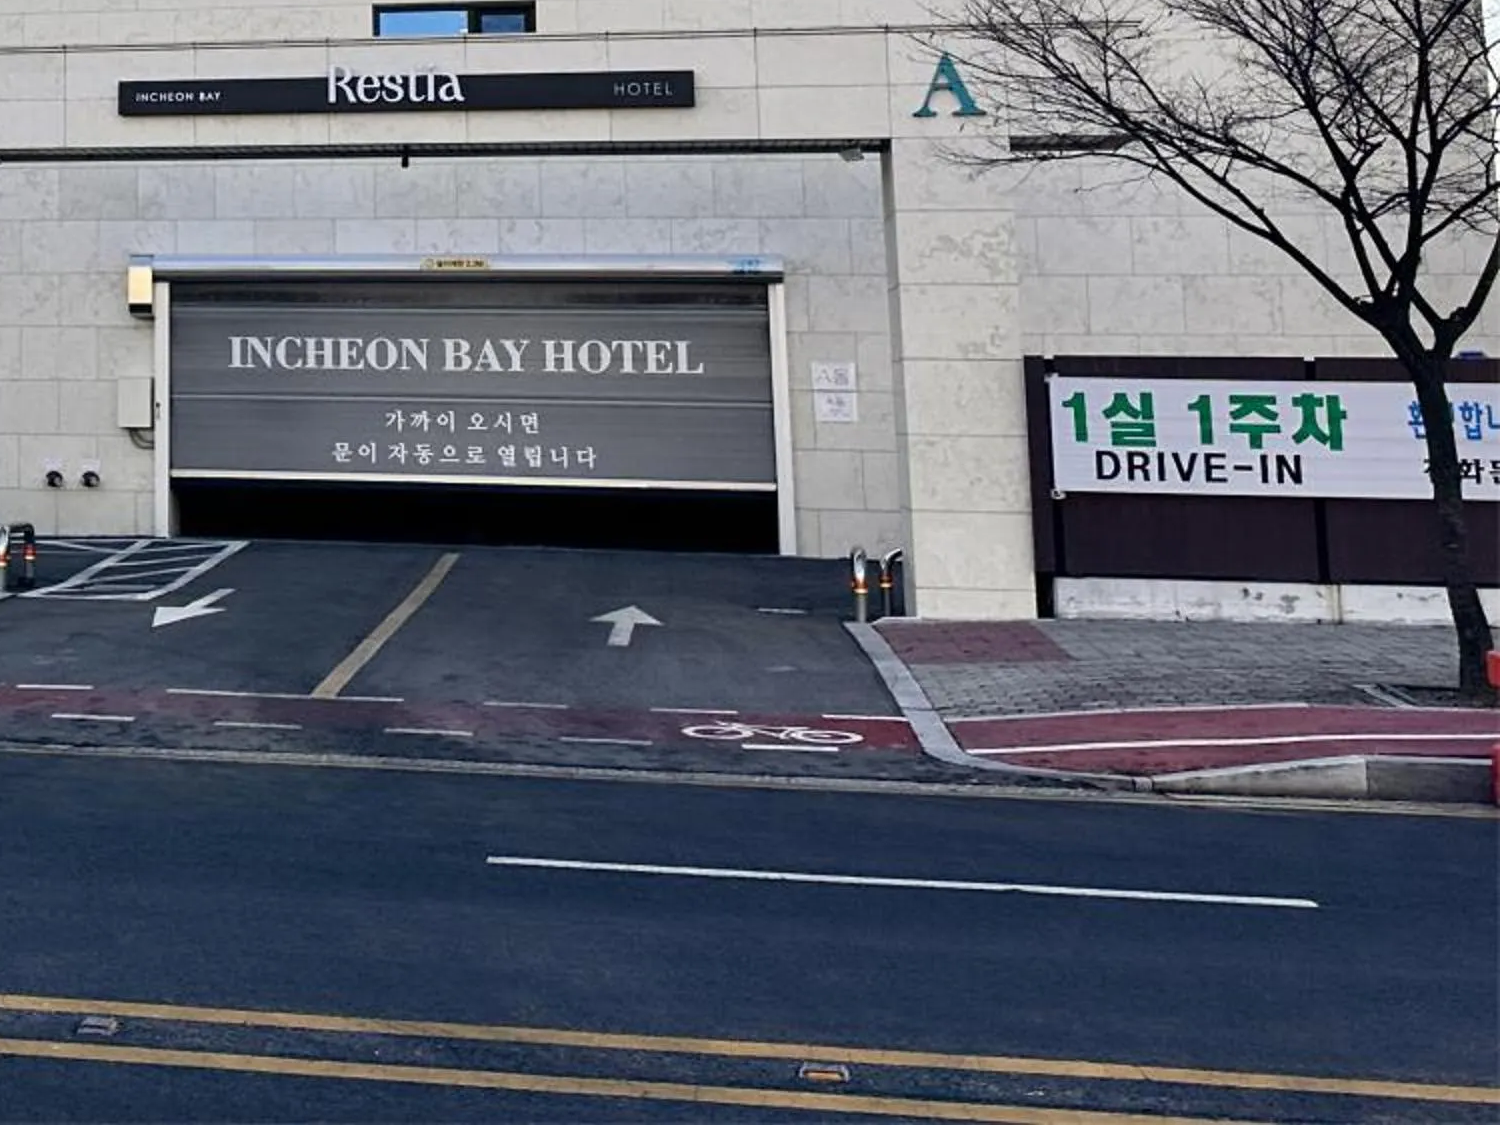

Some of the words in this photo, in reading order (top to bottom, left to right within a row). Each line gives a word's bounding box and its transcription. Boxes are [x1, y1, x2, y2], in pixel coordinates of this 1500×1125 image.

[135, 92, 194, 102] INCHEON
[199, 91, 221, 102] BAY
[328, 63, 465, 104] Restia
[613, 82, 673, 96] HOTEL
[912, 52, 986, 117] A
[227, 335, 430, 371] INCHEON
[442, 338, 530, 372] BAY
[541, 339, 705, 375] HOTEL
[385, 410, 456, 433] 가까이
[467, 412, 540, 434] 오시면
[1061, 391, 1158, 448] 1실
[1187, 393, 1348, 451] 1주차
[332, 442, 377, 464] 문이
[388, 443, 487, 465] 자동으로
[497, 445, 598, 469] 열립니다
[1095, 450, 1304, 485] DRIVE-IN
